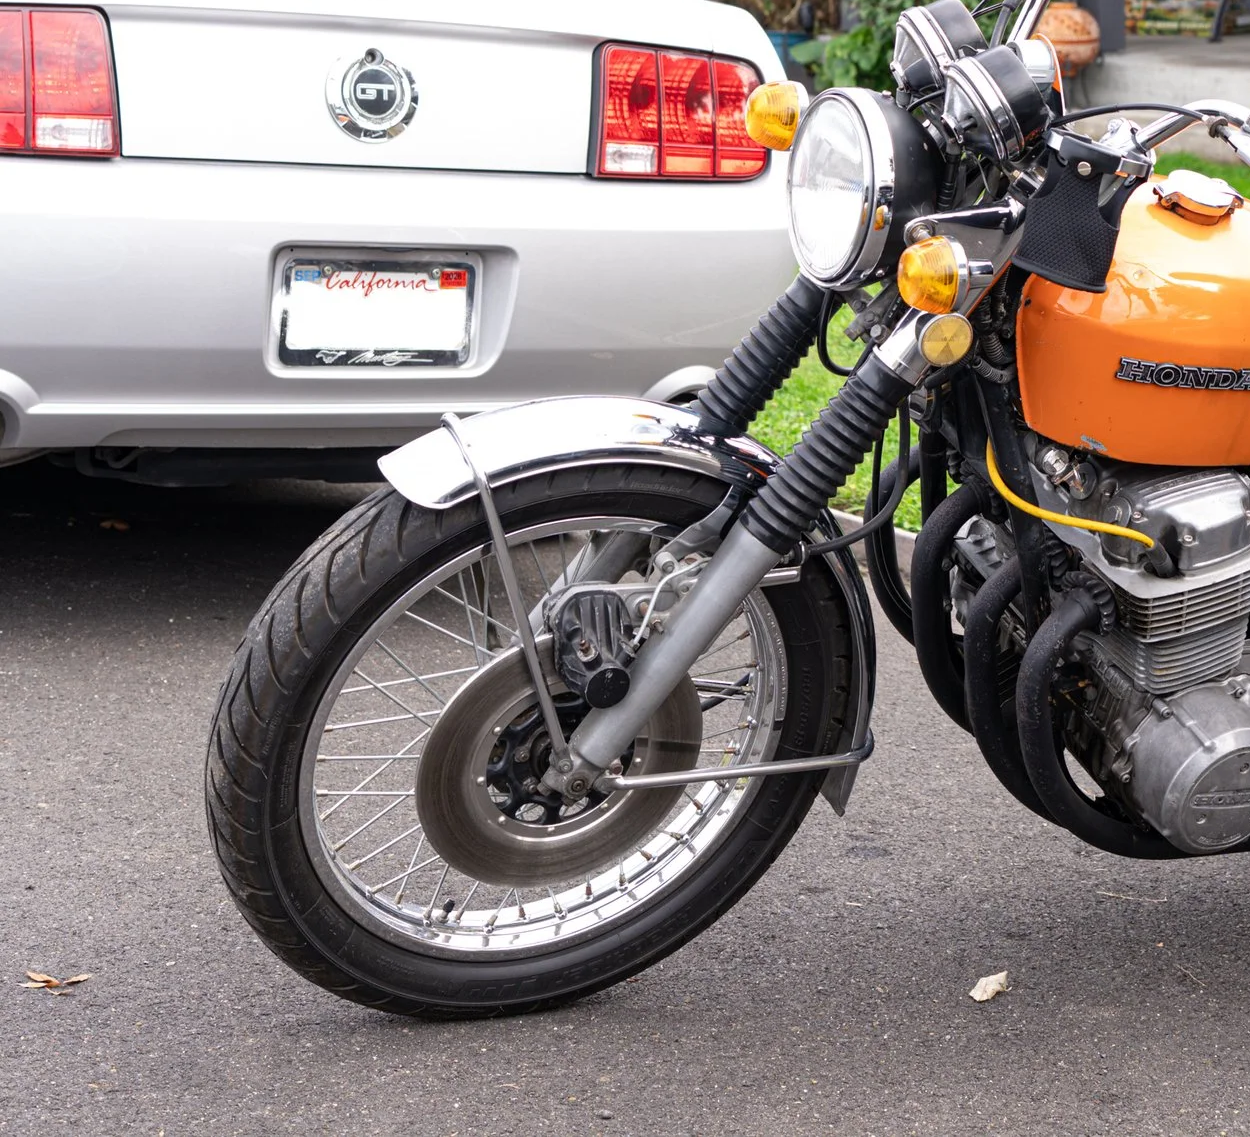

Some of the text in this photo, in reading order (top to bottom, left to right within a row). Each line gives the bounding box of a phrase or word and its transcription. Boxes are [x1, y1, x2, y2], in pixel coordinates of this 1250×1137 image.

[356, 82, 395, 101] GT
[295, 270, 321, 281] SEP
[325, 271, 437, 296] California
